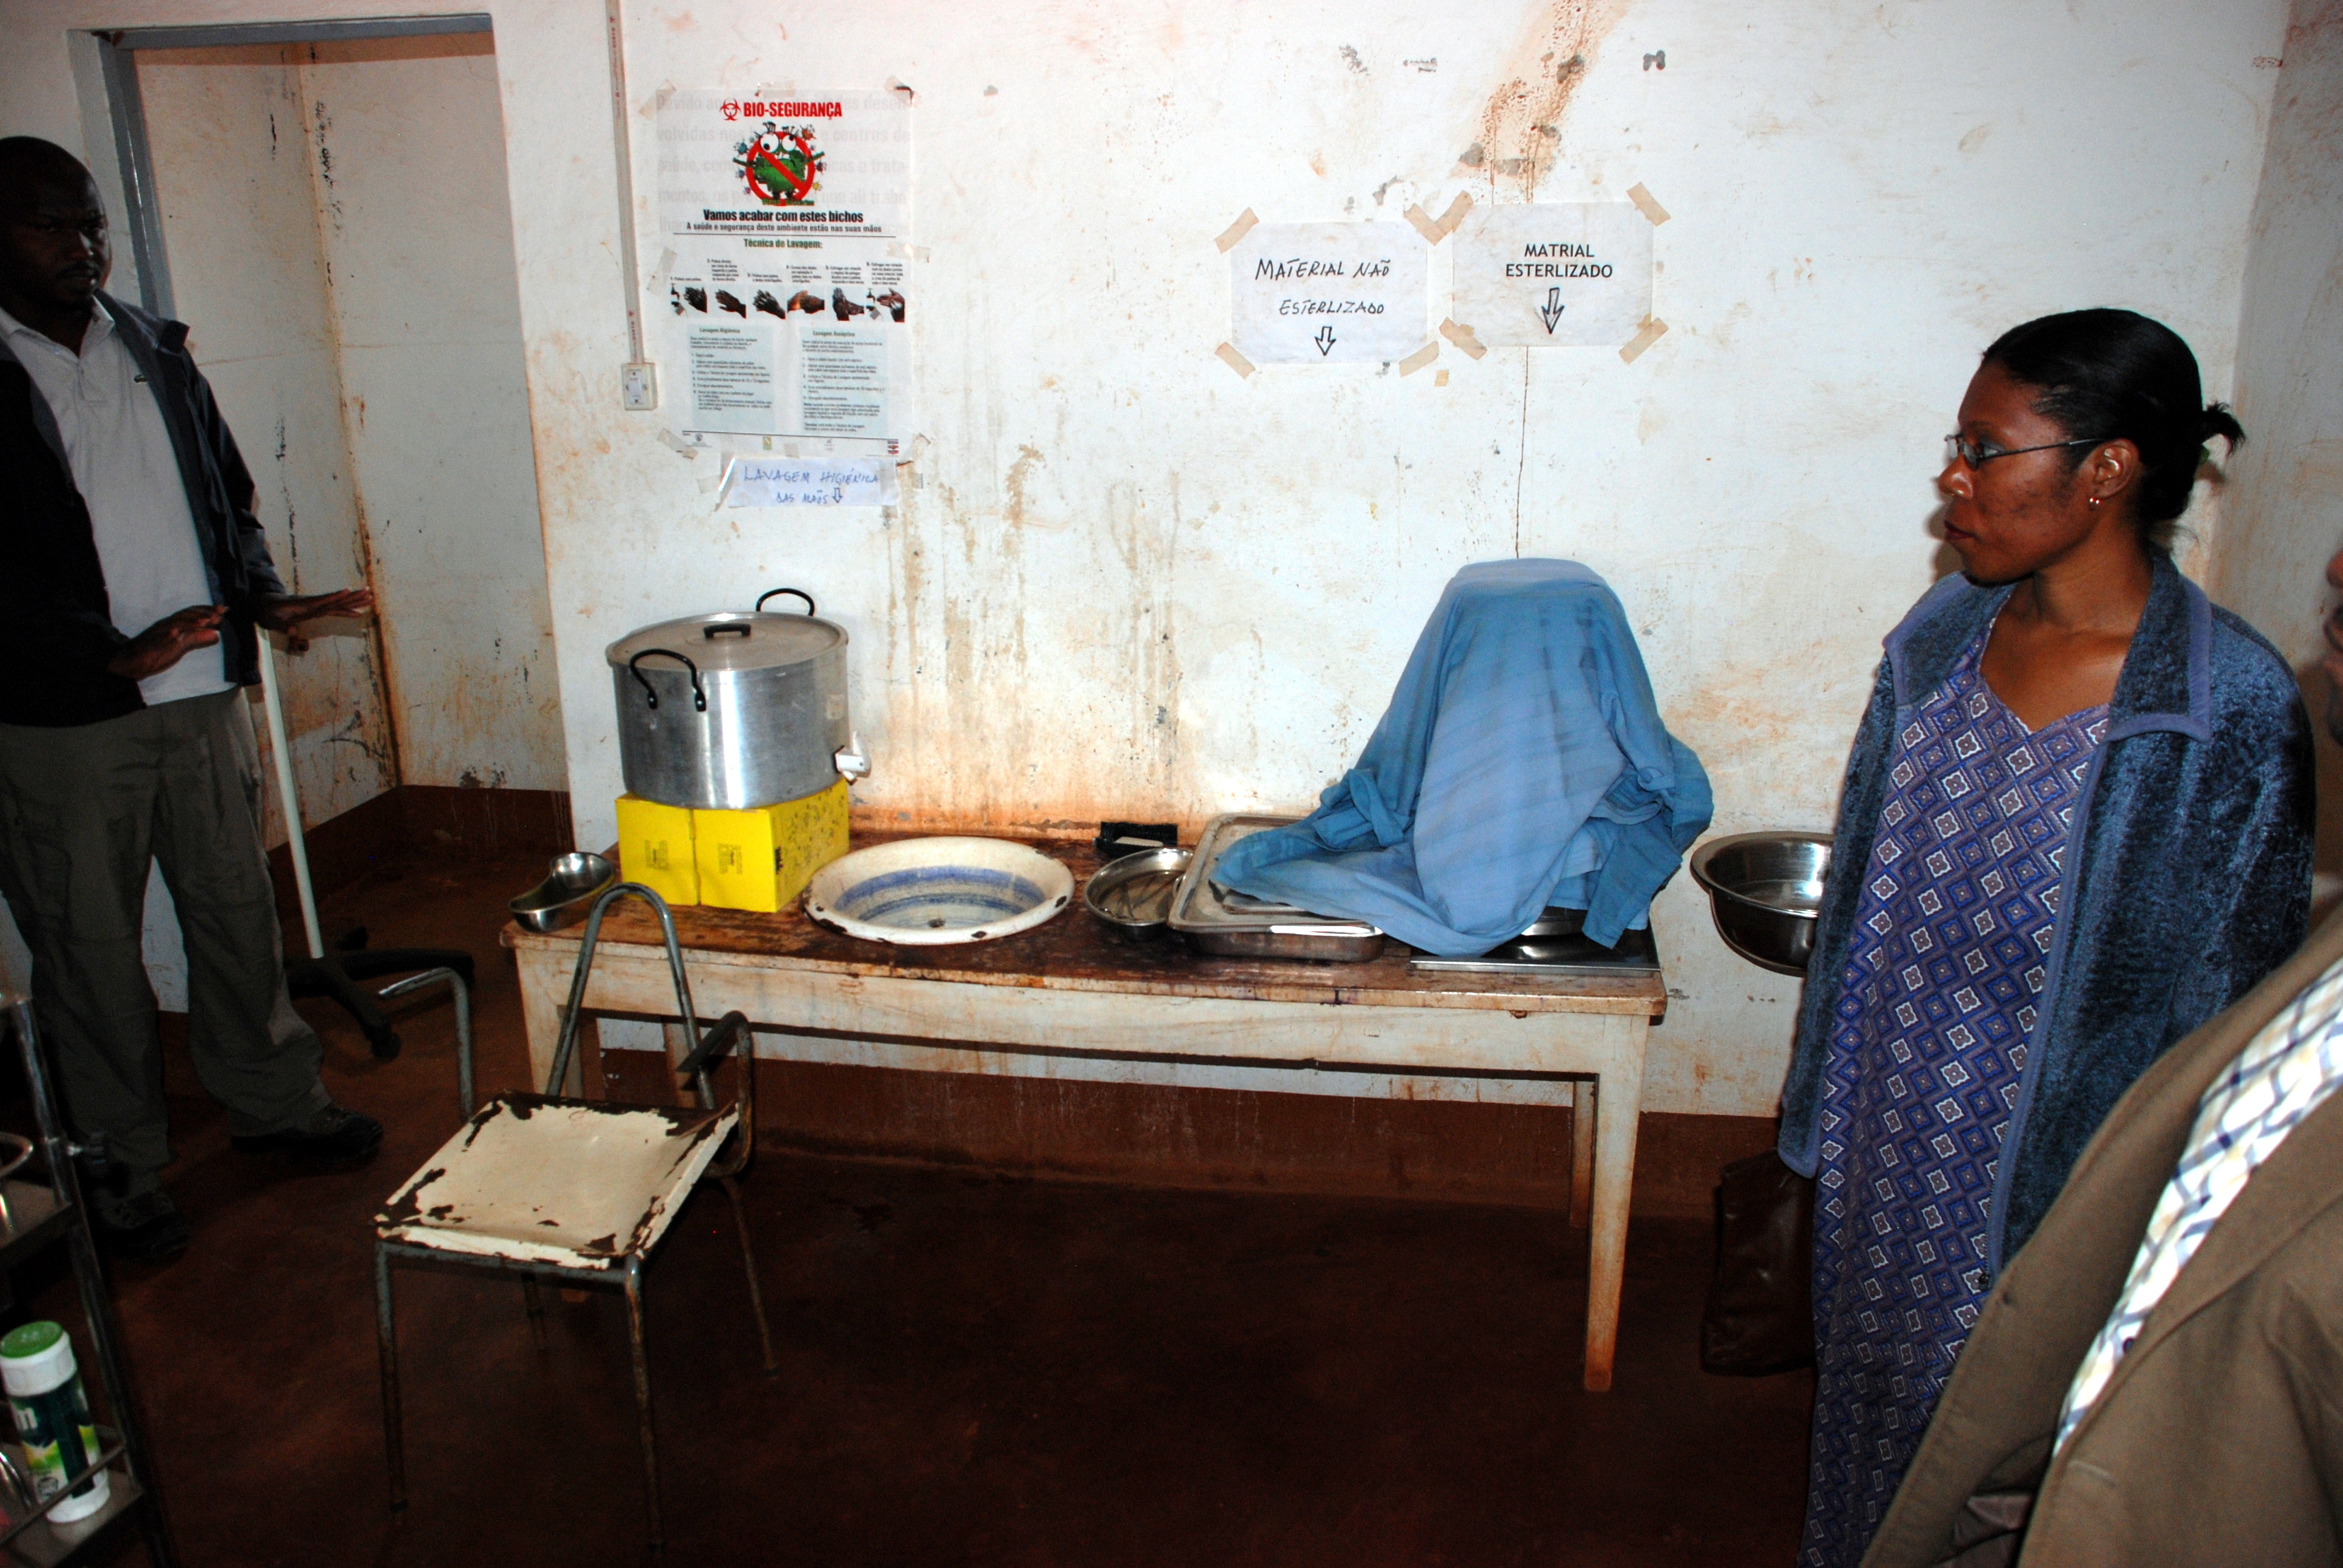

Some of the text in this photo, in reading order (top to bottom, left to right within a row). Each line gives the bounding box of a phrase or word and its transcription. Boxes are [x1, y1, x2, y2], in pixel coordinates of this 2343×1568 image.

[744, 102, 842, 120] BIO-SEGURANÇA
[703, 210, 863, 222] Vamos acabar com estes bichos
[744, 239, 774, 247] Técnica
[787, 240, 822, 249] Lavagem:
[1524, 243, 1594, 258] MATRIAL
[1255, 258, 1345, 280] MATERIAL
[1506, 263, 1613, 278] ESTERLIZADO
[744, 466, 810, 482] LAVAGEM
